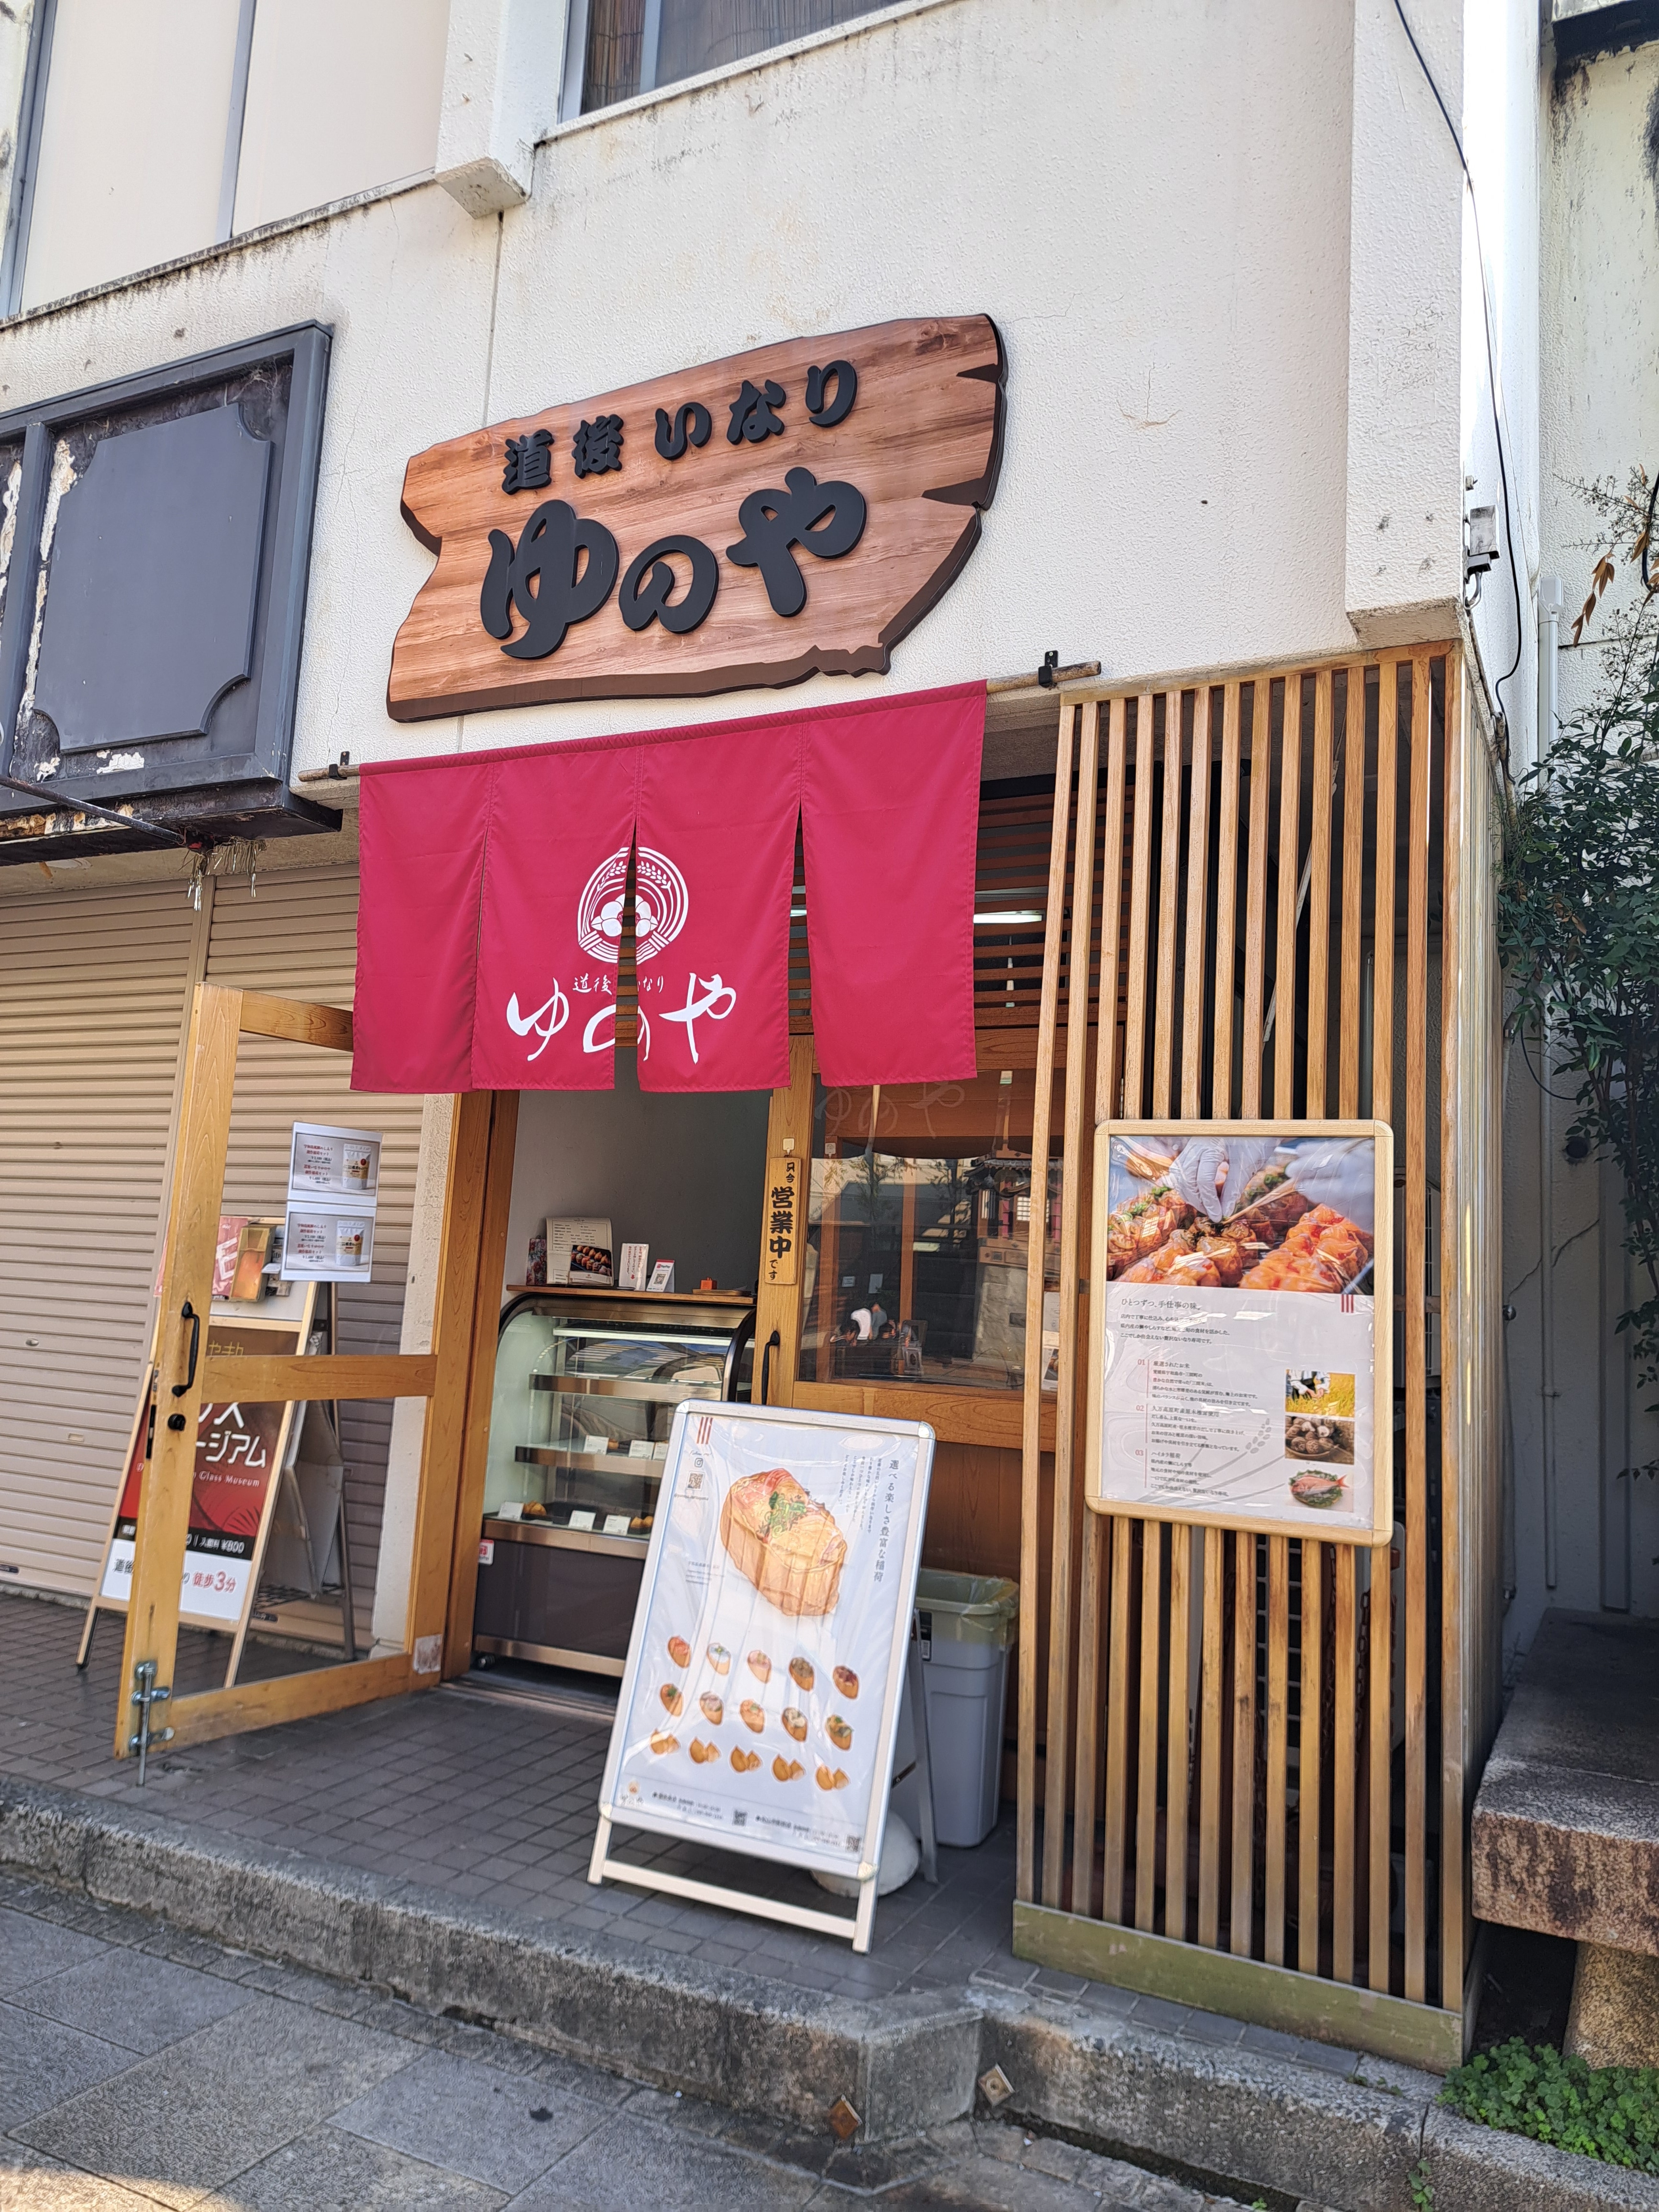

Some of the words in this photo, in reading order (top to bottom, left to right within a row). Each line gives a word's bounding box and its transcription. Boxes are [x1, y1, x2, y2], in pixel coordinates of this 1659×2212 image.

[501, 359, 857, 495] 道後いなり
[480, 467, 866, 658] ゆのや
[572, 973, 664, 995] 道後なり
[506, 973, 737, 1064] ゆのや
[1121, 1298, 1200, 1310] ひとつずつ、手仕事の味。
[199, 1471, 222, 1482] Glass
[224, 1474, 260, 1487] Museum
[874, 1460, 899, 1582] 選べる楽しさ豊富な稲荷
[193, 1571, 236, 1593] 徒歩3分
